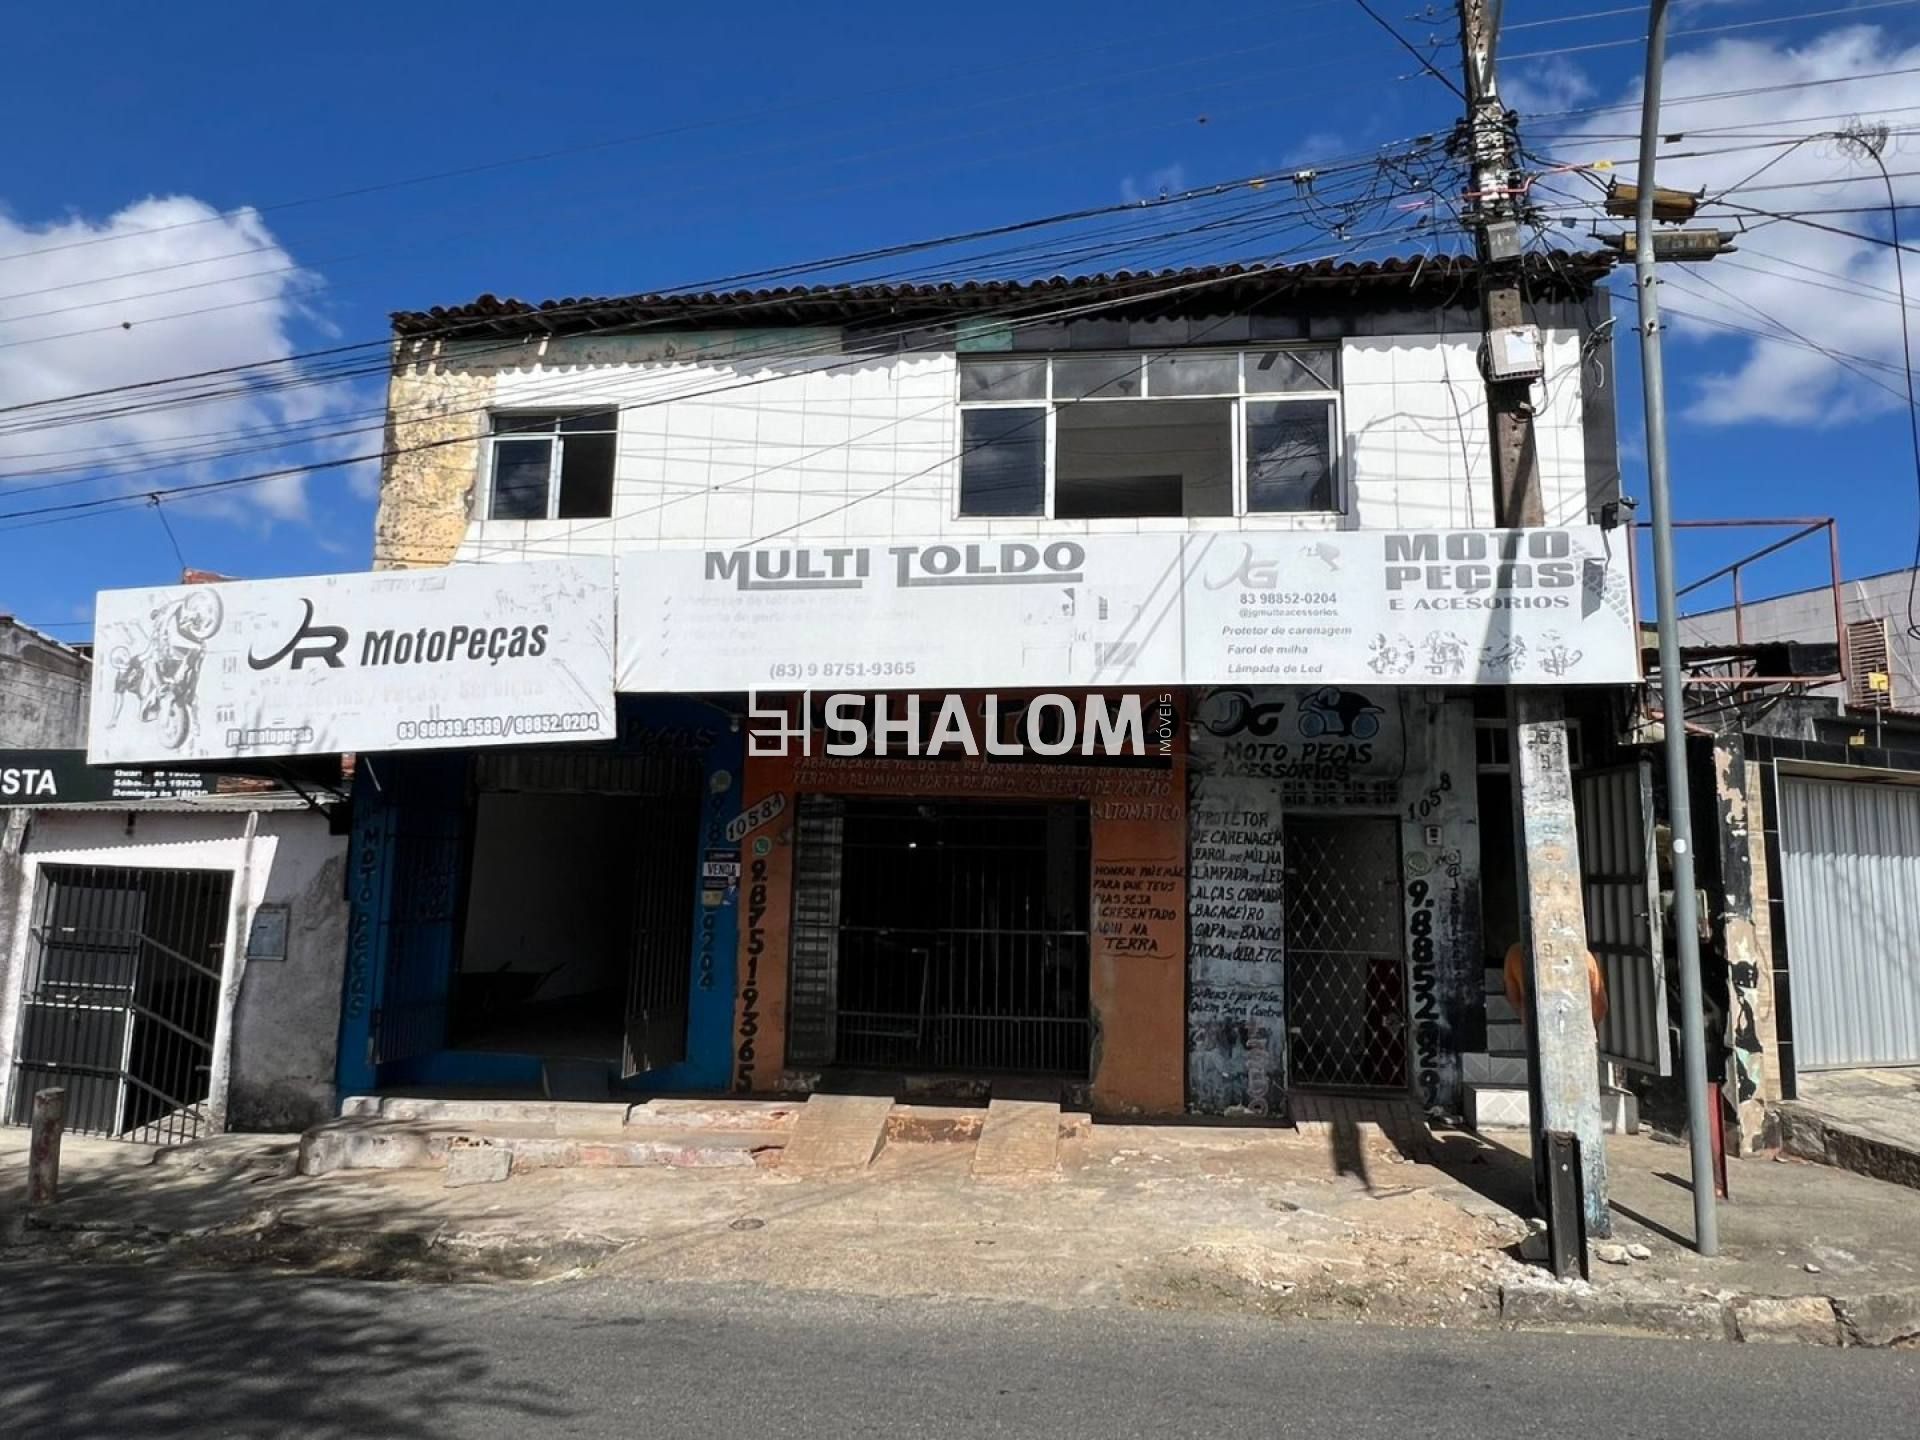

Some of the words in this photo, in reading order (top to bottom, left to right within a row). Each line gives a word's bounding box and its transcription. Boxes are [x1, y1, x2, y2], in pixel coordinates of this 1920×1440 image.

[1384, 531, 1570, 561] MOTO
[704, 548, 870, 590] MULTI
[889, 541, 1086, 588] TOLDO
[1384, 562, 1575, 596] PEÇAS
[1240, 592, 1256, 605] 83
[1260, 592, 1337, 605] 98852-0204
[1389, 598, 1405, 610] E
[1222, 625, 1268, 635] Protetor
[1271, 625, 1286, 635] de
[360, 623, 551, 667] MotoPeças
[1227, 644, 1257, 655] Farol
[1259, 644, 1274, 654] de
[1276, 644, 1309, 655] milha
[769, 663, 803, 679] (83)
[807, 663, 818, 677] 9
[823, 661, 916, 677] 8751-9365
[1284, 664, 1297, 673] de
[1300, 664, 1323, 674] Led
[397, 721, 416, 740] 83
[1224, 742, 1288, 761] MOTO
[1302, 743, 1372, 766] PEÇAS
[0, 769, 57, 796] STA
[1409, 770, 1452, 819] 1058
[1130, 922, 1148, 936] NA
[1104, 937, 1158, 951] TERRA
